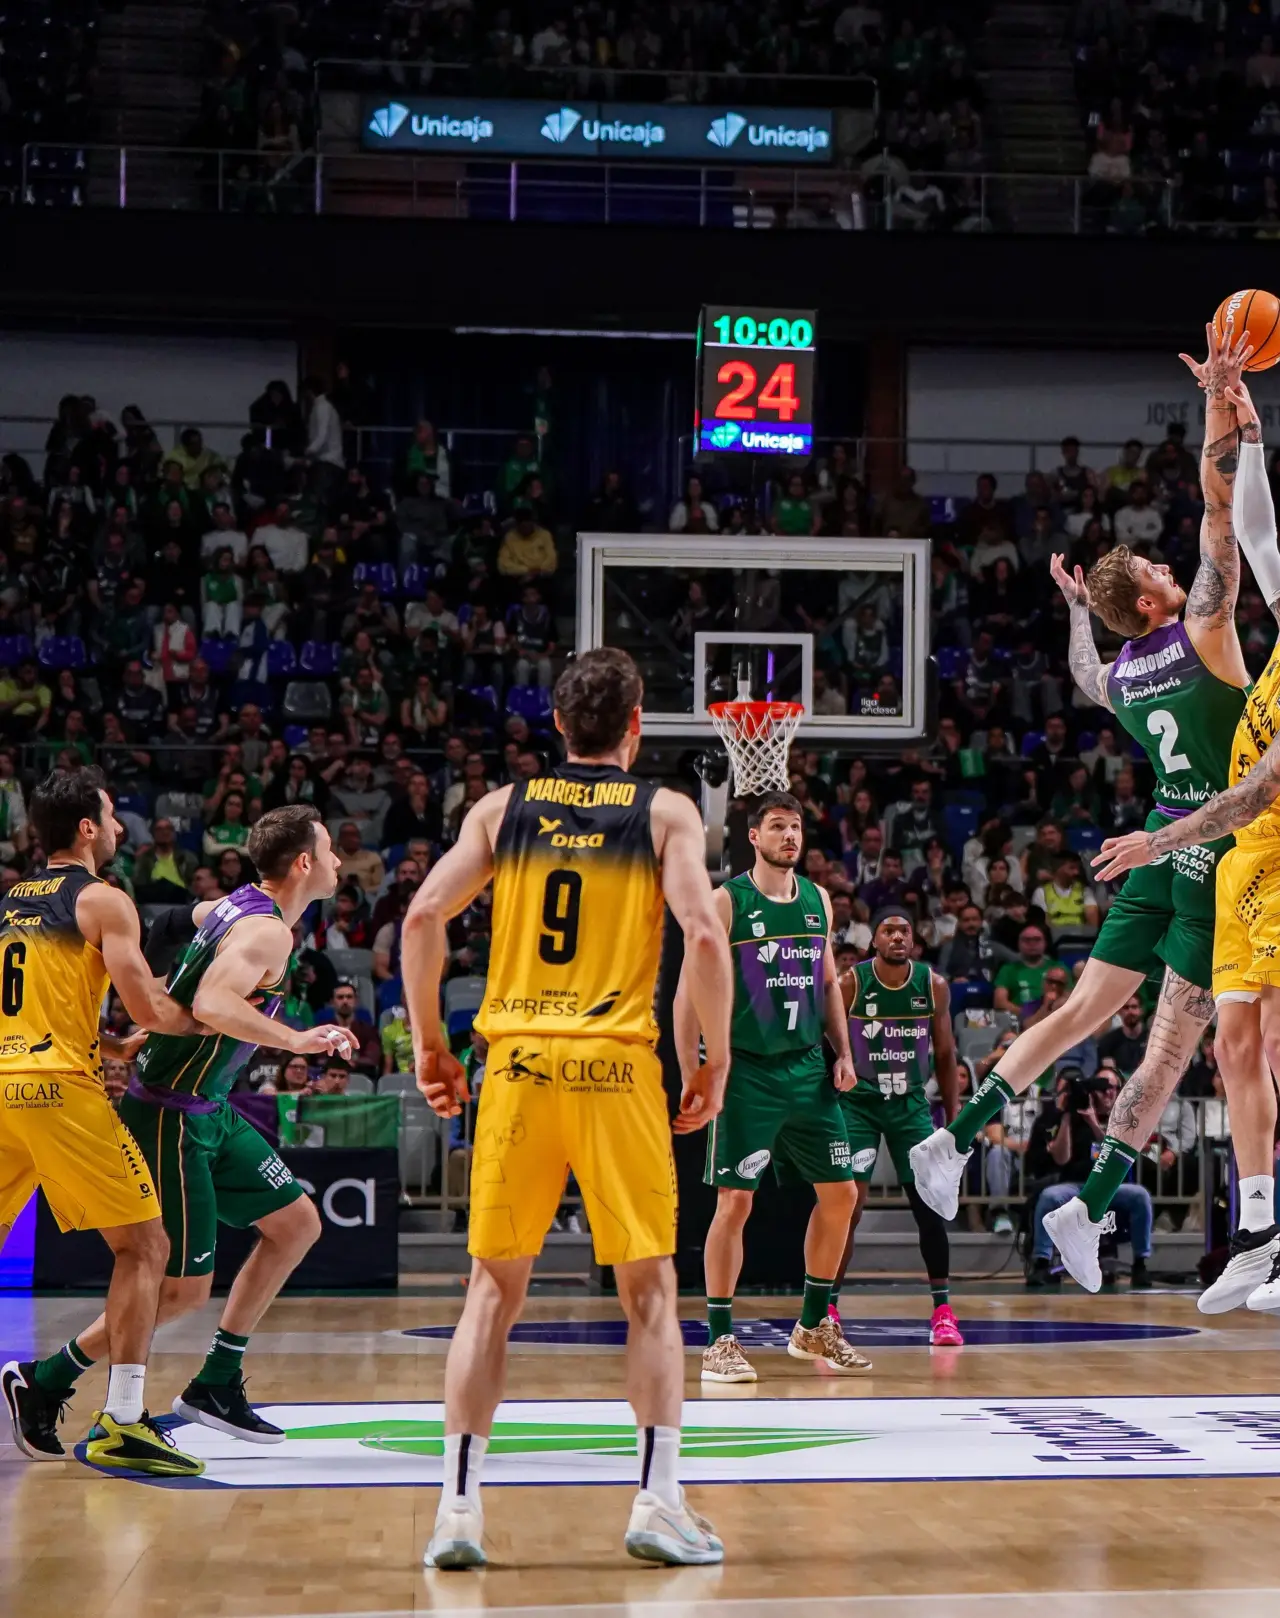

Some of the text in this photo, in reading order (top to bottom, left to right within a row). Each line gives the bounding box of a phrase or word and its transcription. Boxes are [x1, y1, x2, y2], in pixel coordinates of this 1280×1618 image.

[411, 115, 493, 142] Unicaja
[582, 120, 665, 147] Unicaja
[747, 125, 829, 152] Unicaja
[713, 315, 813, 347] 10:00
[715, 360, 800, 420] 24
[741, 431, 804, 453] Unicaja
[1146, 709, 1192, 774] 2
[525, 778, 637, 808] MARCELINHO
[538, 869, 582, 965] 9
[781, 945, 822, 964] Unicaja
[1, 942, 27, 1017] 6
[541, 989, 579, 998] IBERIA
[488, 998, 578, 1017] EXPRESS
[783, 1001, 799, 1031] 7
[884, 1026, 927, 1038] Unicaja
[561, 1059, 635, 1084] CICAR
[876, 1072, 908, 1096] 55
[4, 1083, 64, 1101] CICAR
